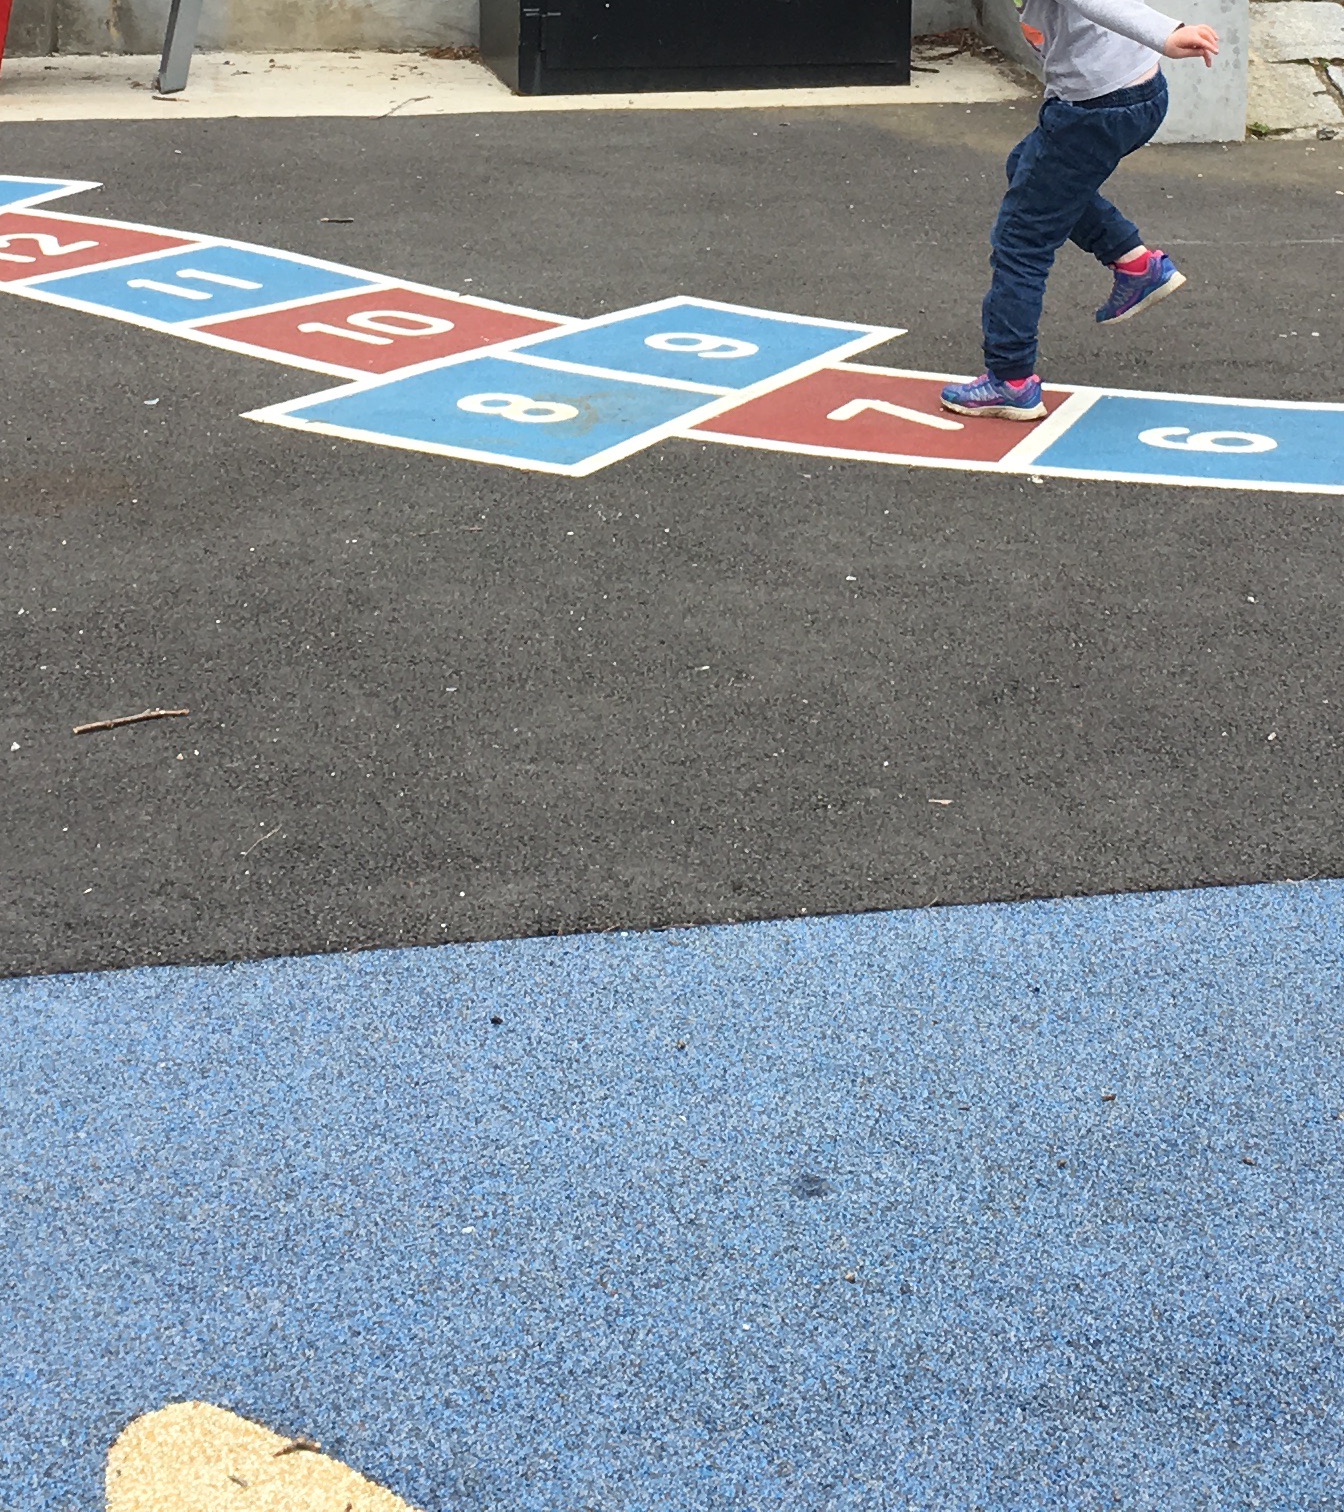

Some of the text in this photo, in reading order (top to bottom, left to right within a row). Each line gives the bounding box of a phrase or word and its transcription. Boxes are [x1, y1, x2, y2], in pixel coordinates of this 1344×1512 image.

[127, 268, 263, 301] 11
[297, 309, 455, 346] 10
[644, 332, 759, 361] 9
[456, 392, 579, 424] 8
[826, 398, 965, 431] 7
[1138, 426, 1279, 454] 6
